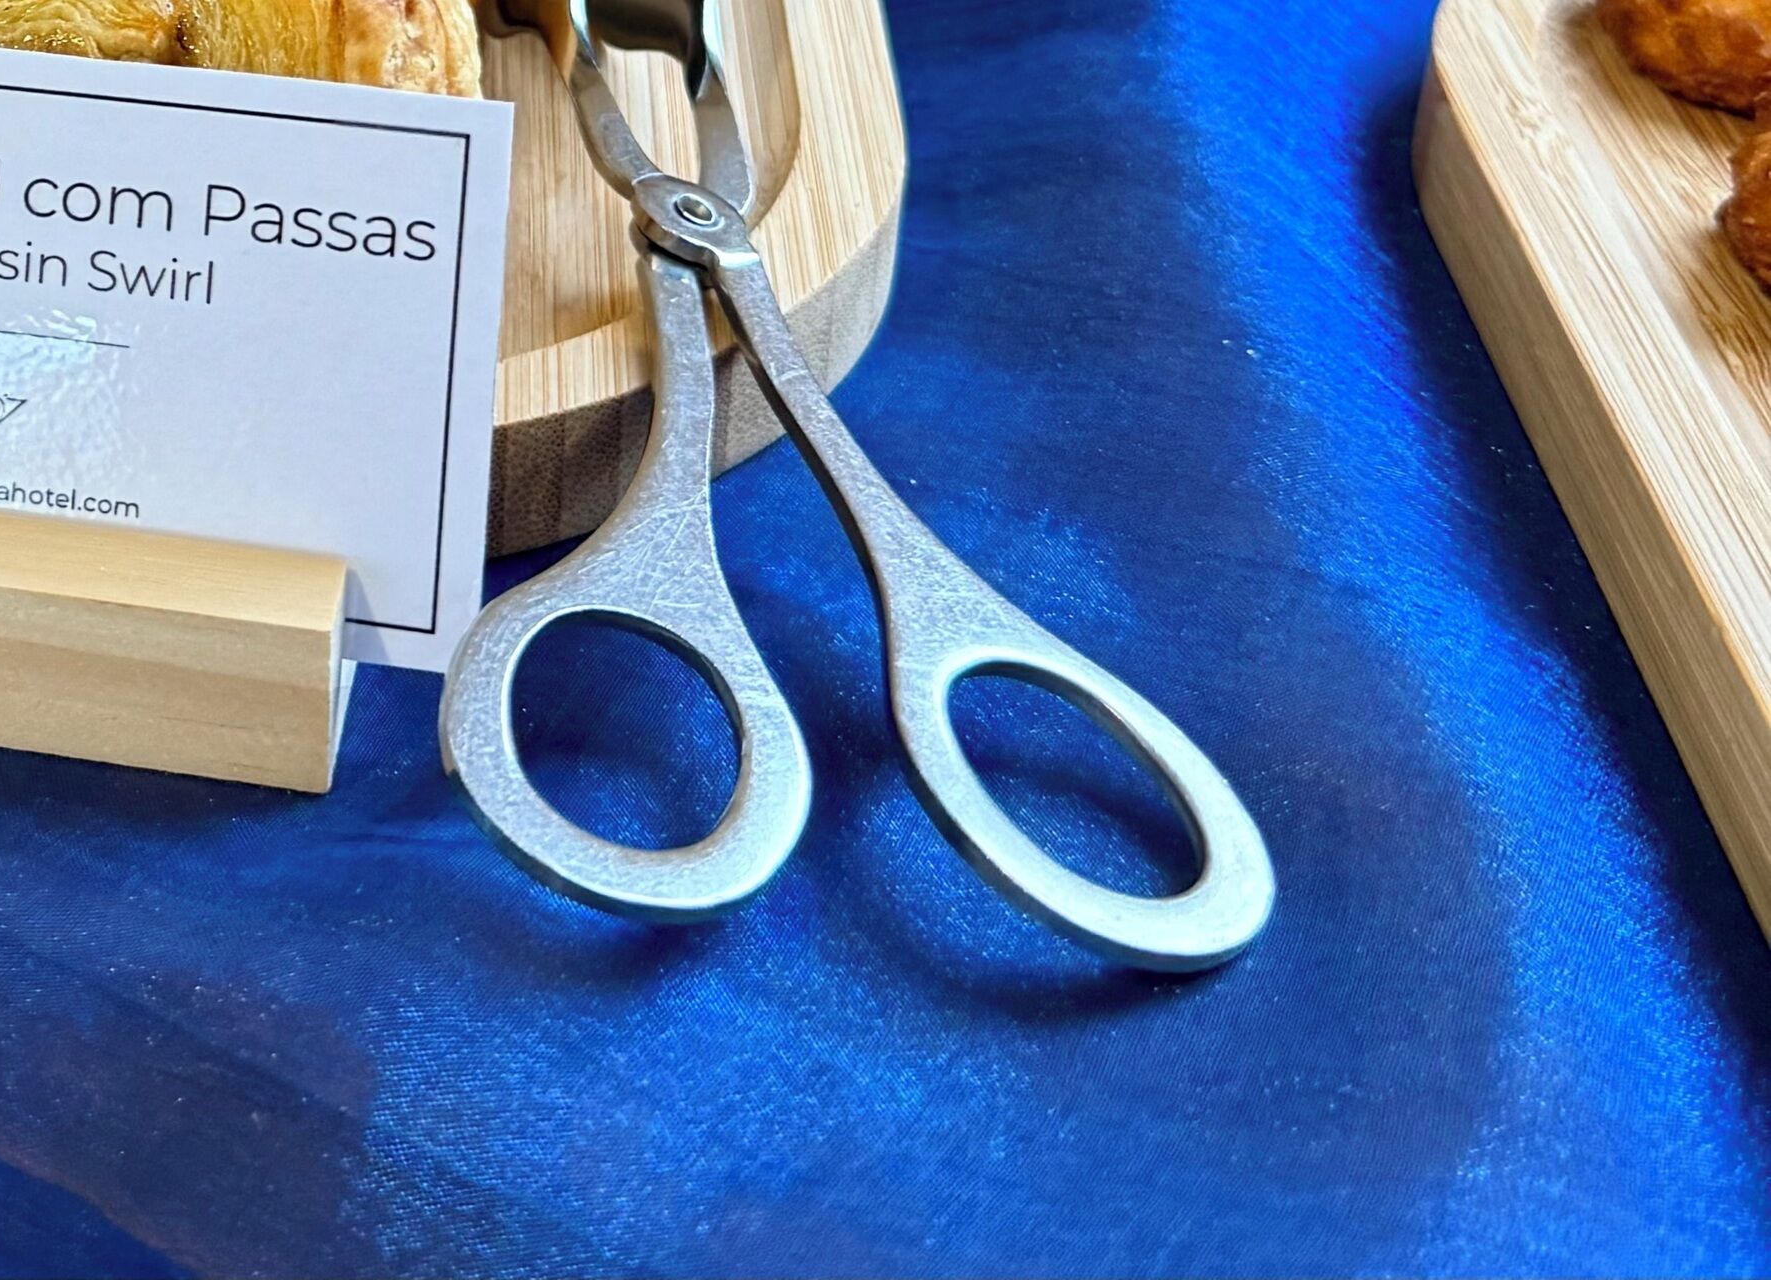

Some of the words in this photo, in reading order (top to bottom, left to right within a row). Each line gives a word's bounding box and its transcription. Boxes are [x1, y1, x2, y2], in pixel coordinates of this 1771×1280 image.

[23, 177, 174, 232] com
[203, 183, 438, 262] Passas
[86, 249, 215, 305] Swirl
